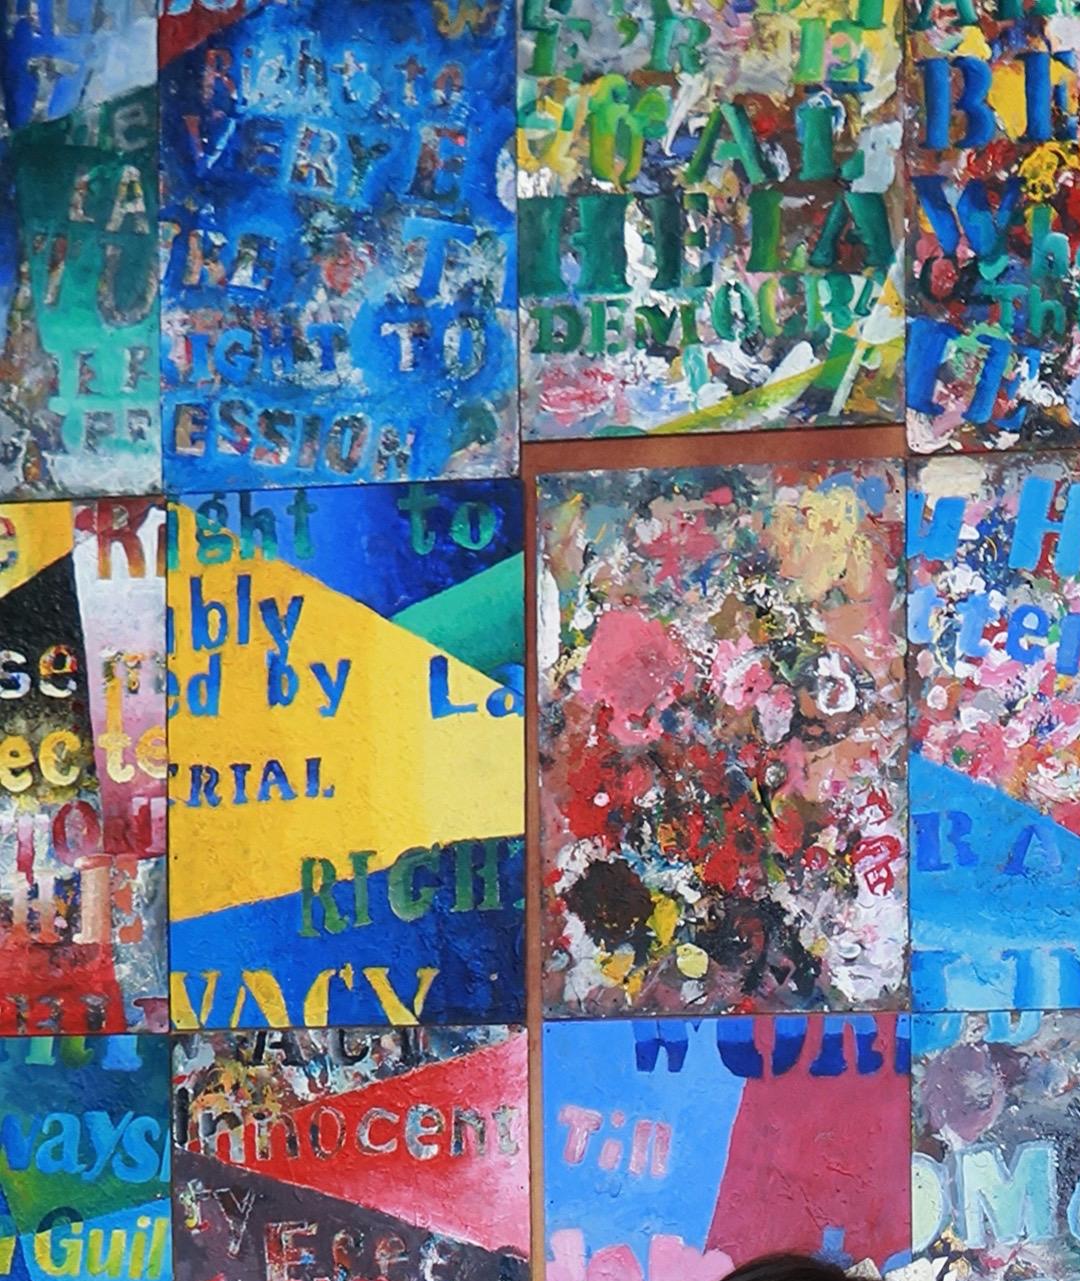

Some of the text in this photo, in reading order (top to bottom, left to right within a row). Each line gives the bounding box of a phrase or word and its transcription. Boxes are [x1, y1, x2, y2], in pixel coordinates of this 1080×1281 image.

[398, 482, 497, 557] to
[266, 650, 353, 718] by
[556, 1105, 673, 1179] Till
